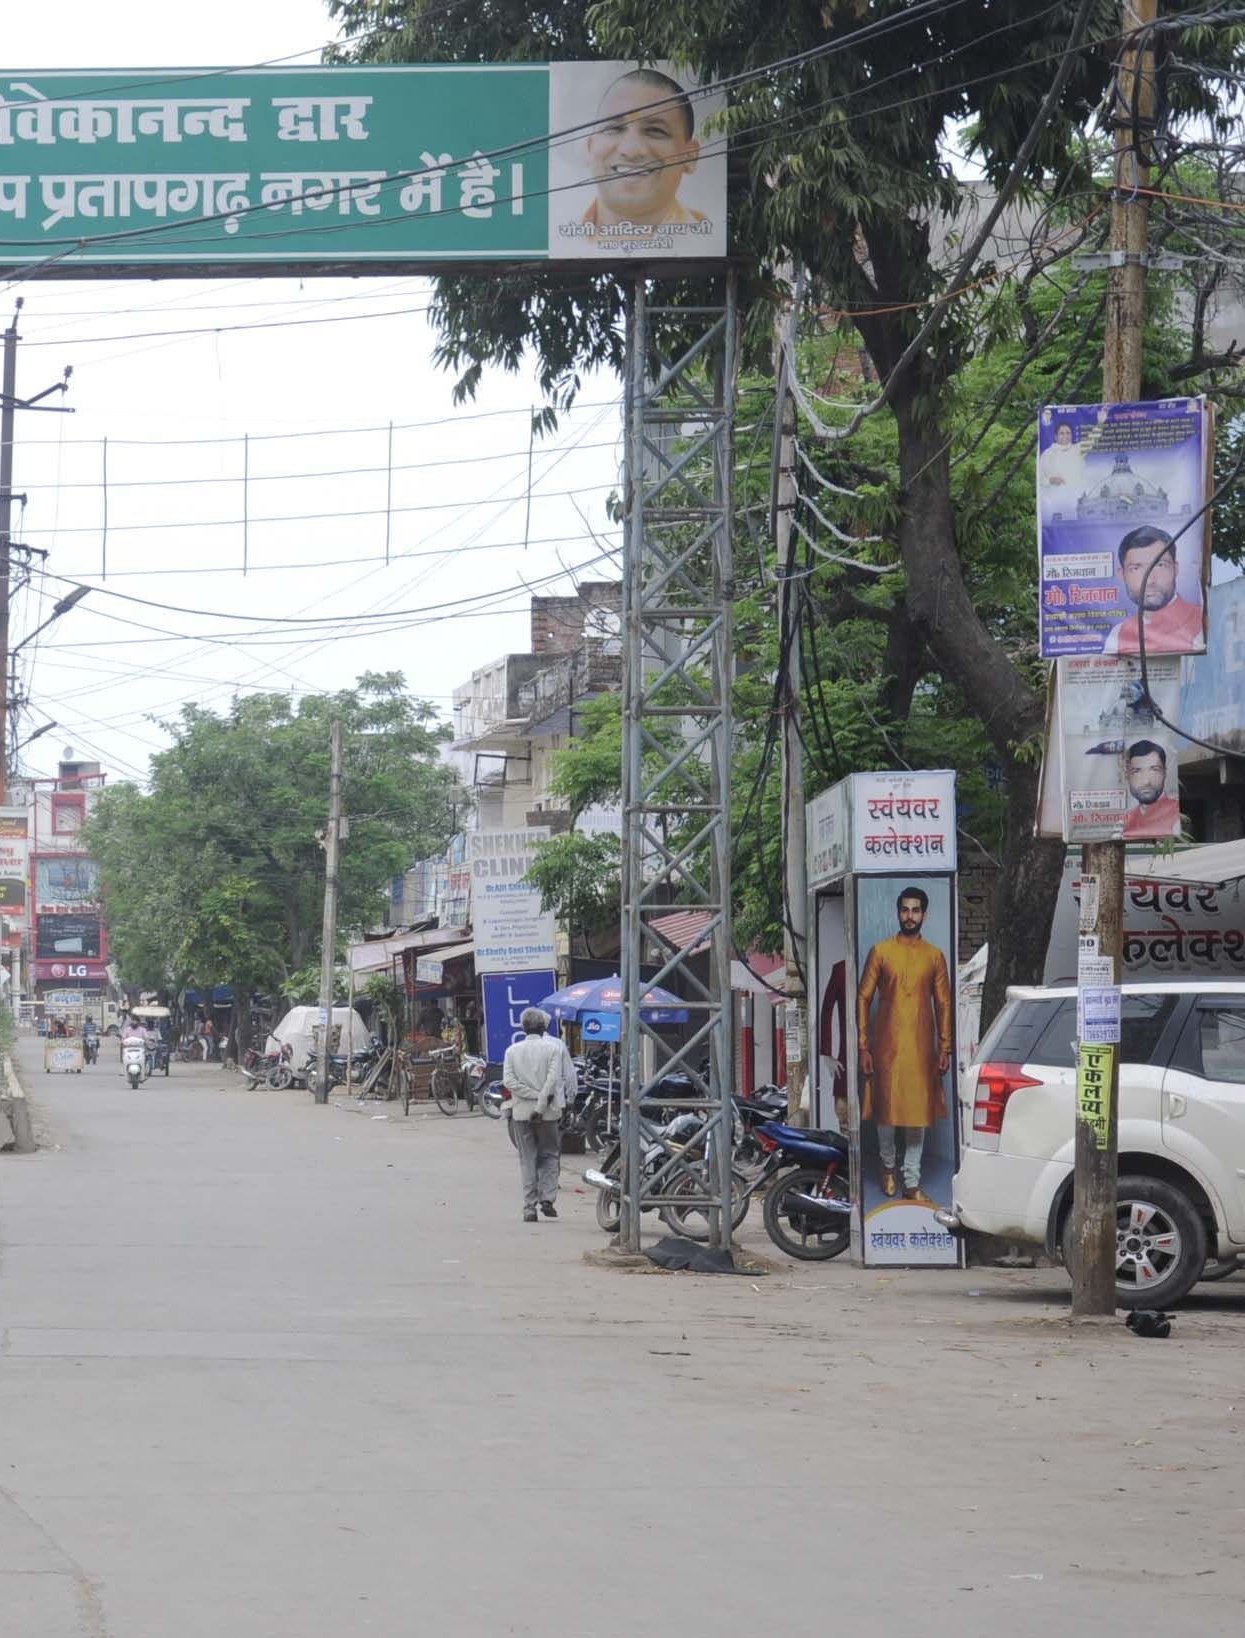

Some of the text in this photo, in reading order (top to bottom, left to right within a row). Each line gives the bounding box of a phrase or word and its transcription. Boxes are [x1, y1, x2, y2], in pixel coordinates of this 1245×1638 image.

[271, 96, 374, 142] द्वार
[260, 171, 387, 216] नगर
[399, 151, 454, 213] में
[864, 827, 945, 855] कलेक्शन
[474, 857, 533, 878] CLINI
[68, 965, 87, 977] LG
[587, 1022, 600, 1031] Jio
